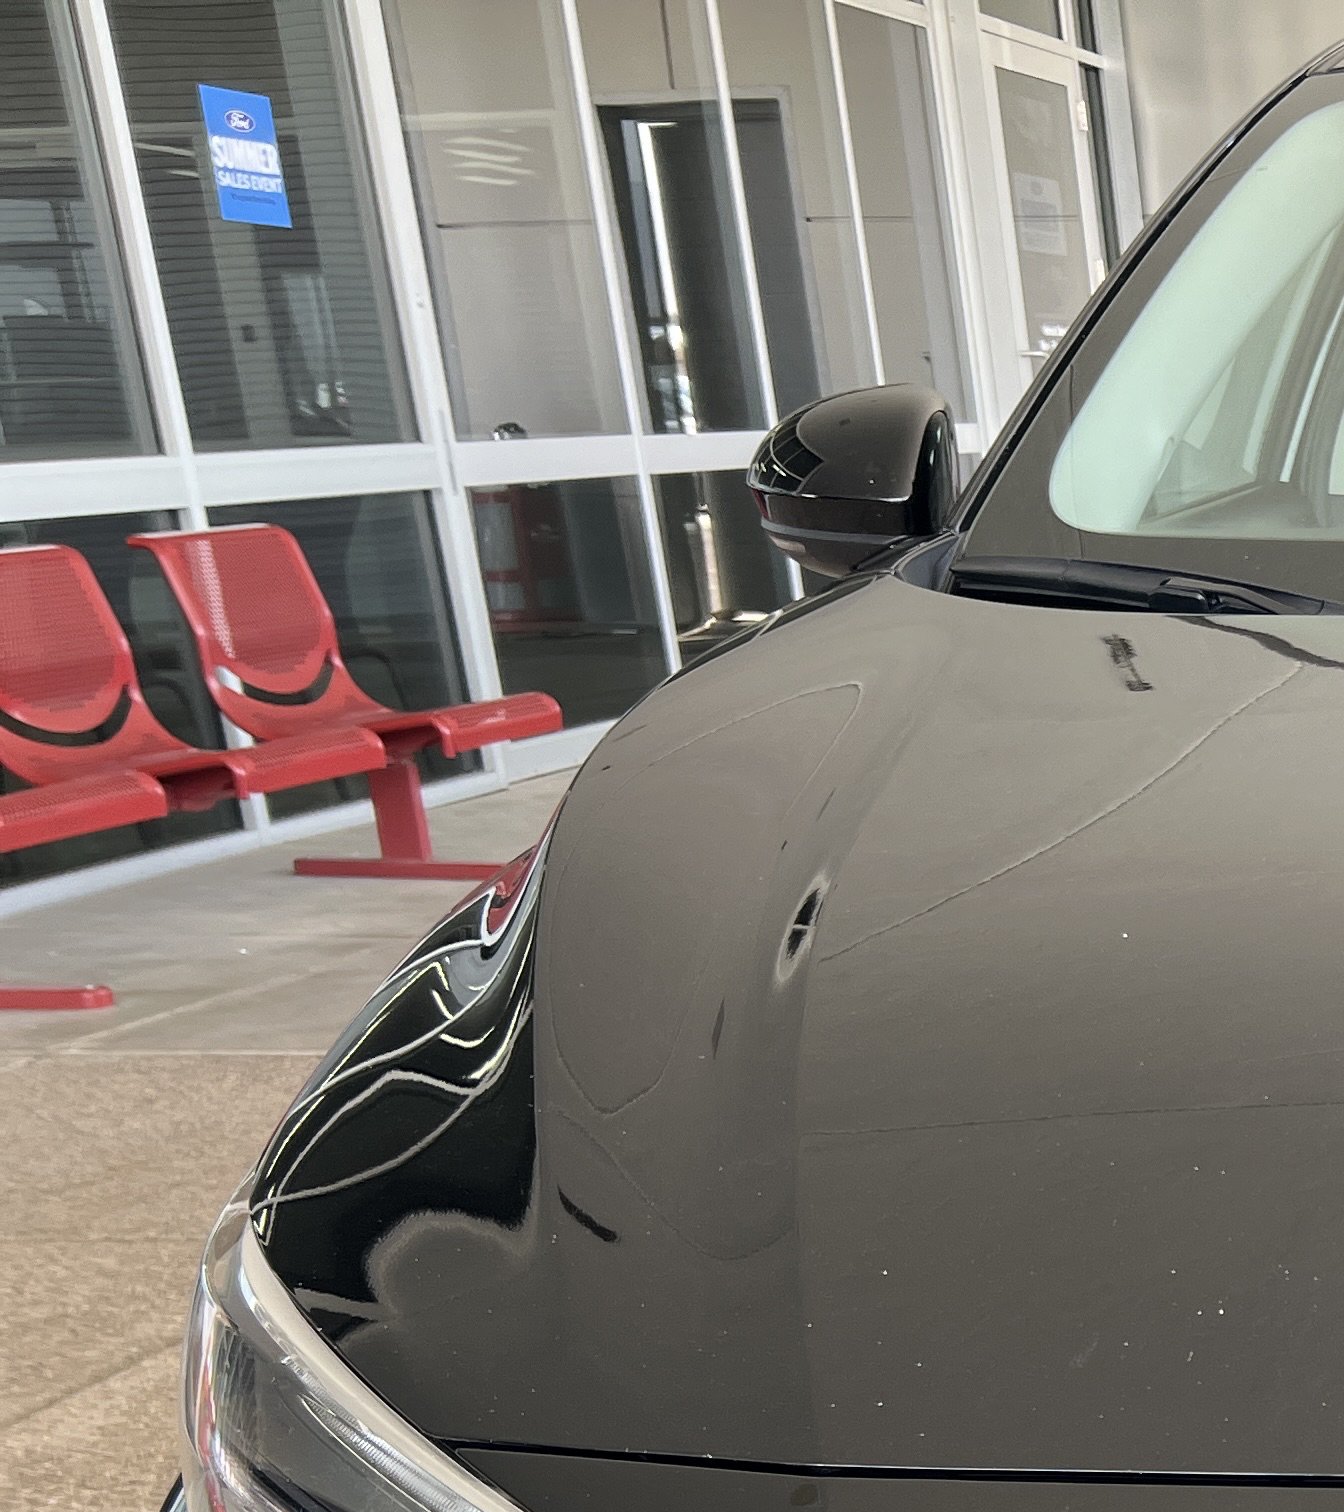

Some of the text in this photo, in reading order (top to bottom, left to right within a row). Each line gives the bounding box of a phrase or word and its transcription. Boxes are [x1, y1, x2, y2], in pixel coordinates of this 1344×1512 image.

[230, 112, 250, 130] Ford
[211, 135, 281, 176] SUMMER
[217, 170, 282, 194] SALES EVENT
